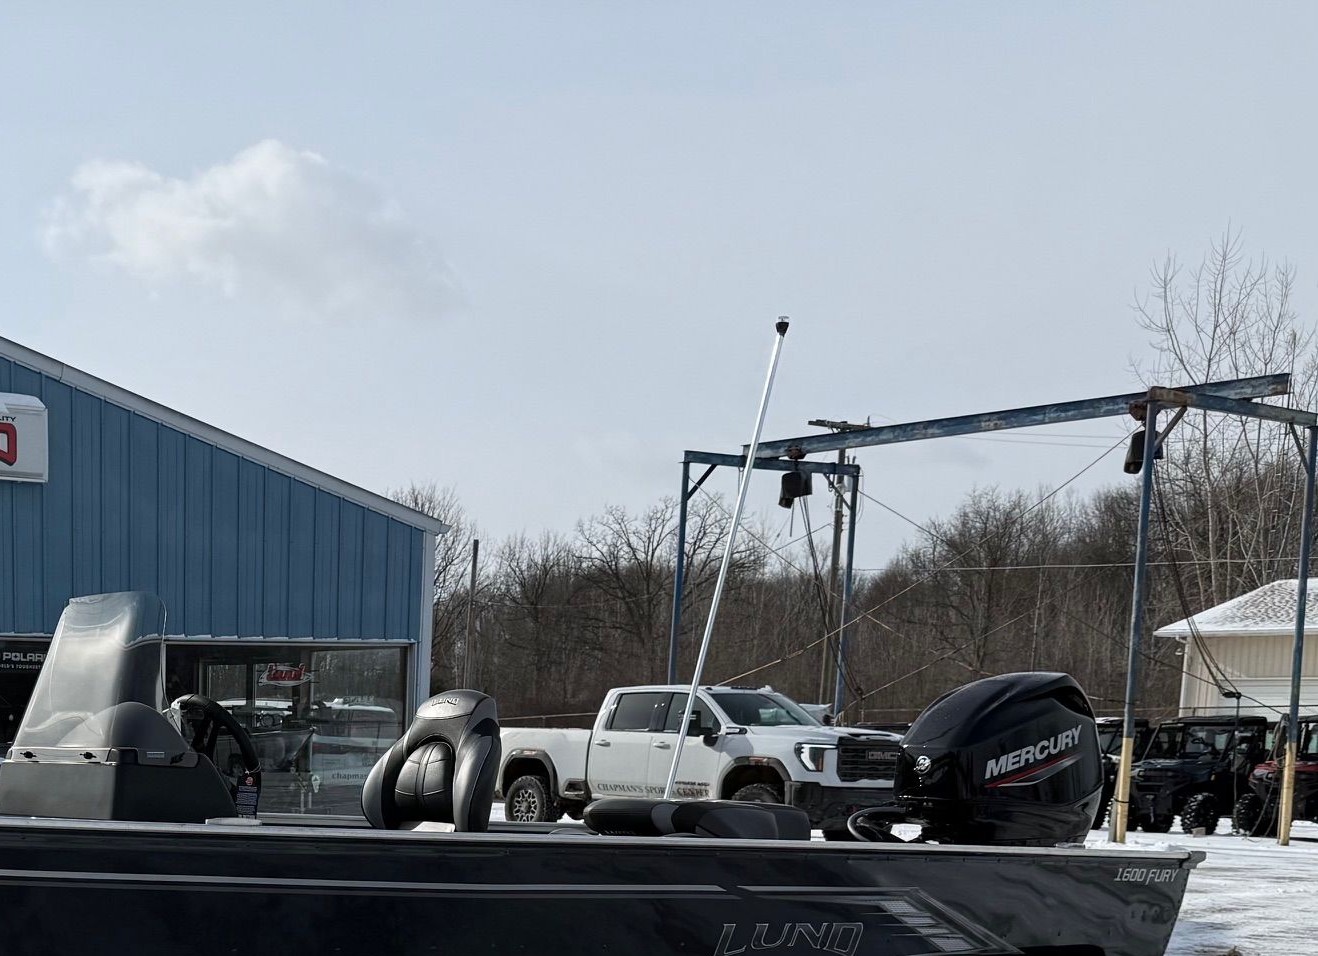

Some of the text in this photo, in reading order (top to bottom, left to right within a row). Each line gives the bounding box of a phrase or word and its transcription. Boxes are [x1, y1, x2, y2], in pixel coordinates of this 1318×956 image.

[3, 652, 47, 662] POLAR
[985, 725, 1083, 779] MERCURY
[1113, 867, 1179, 886] 1600 FURY
